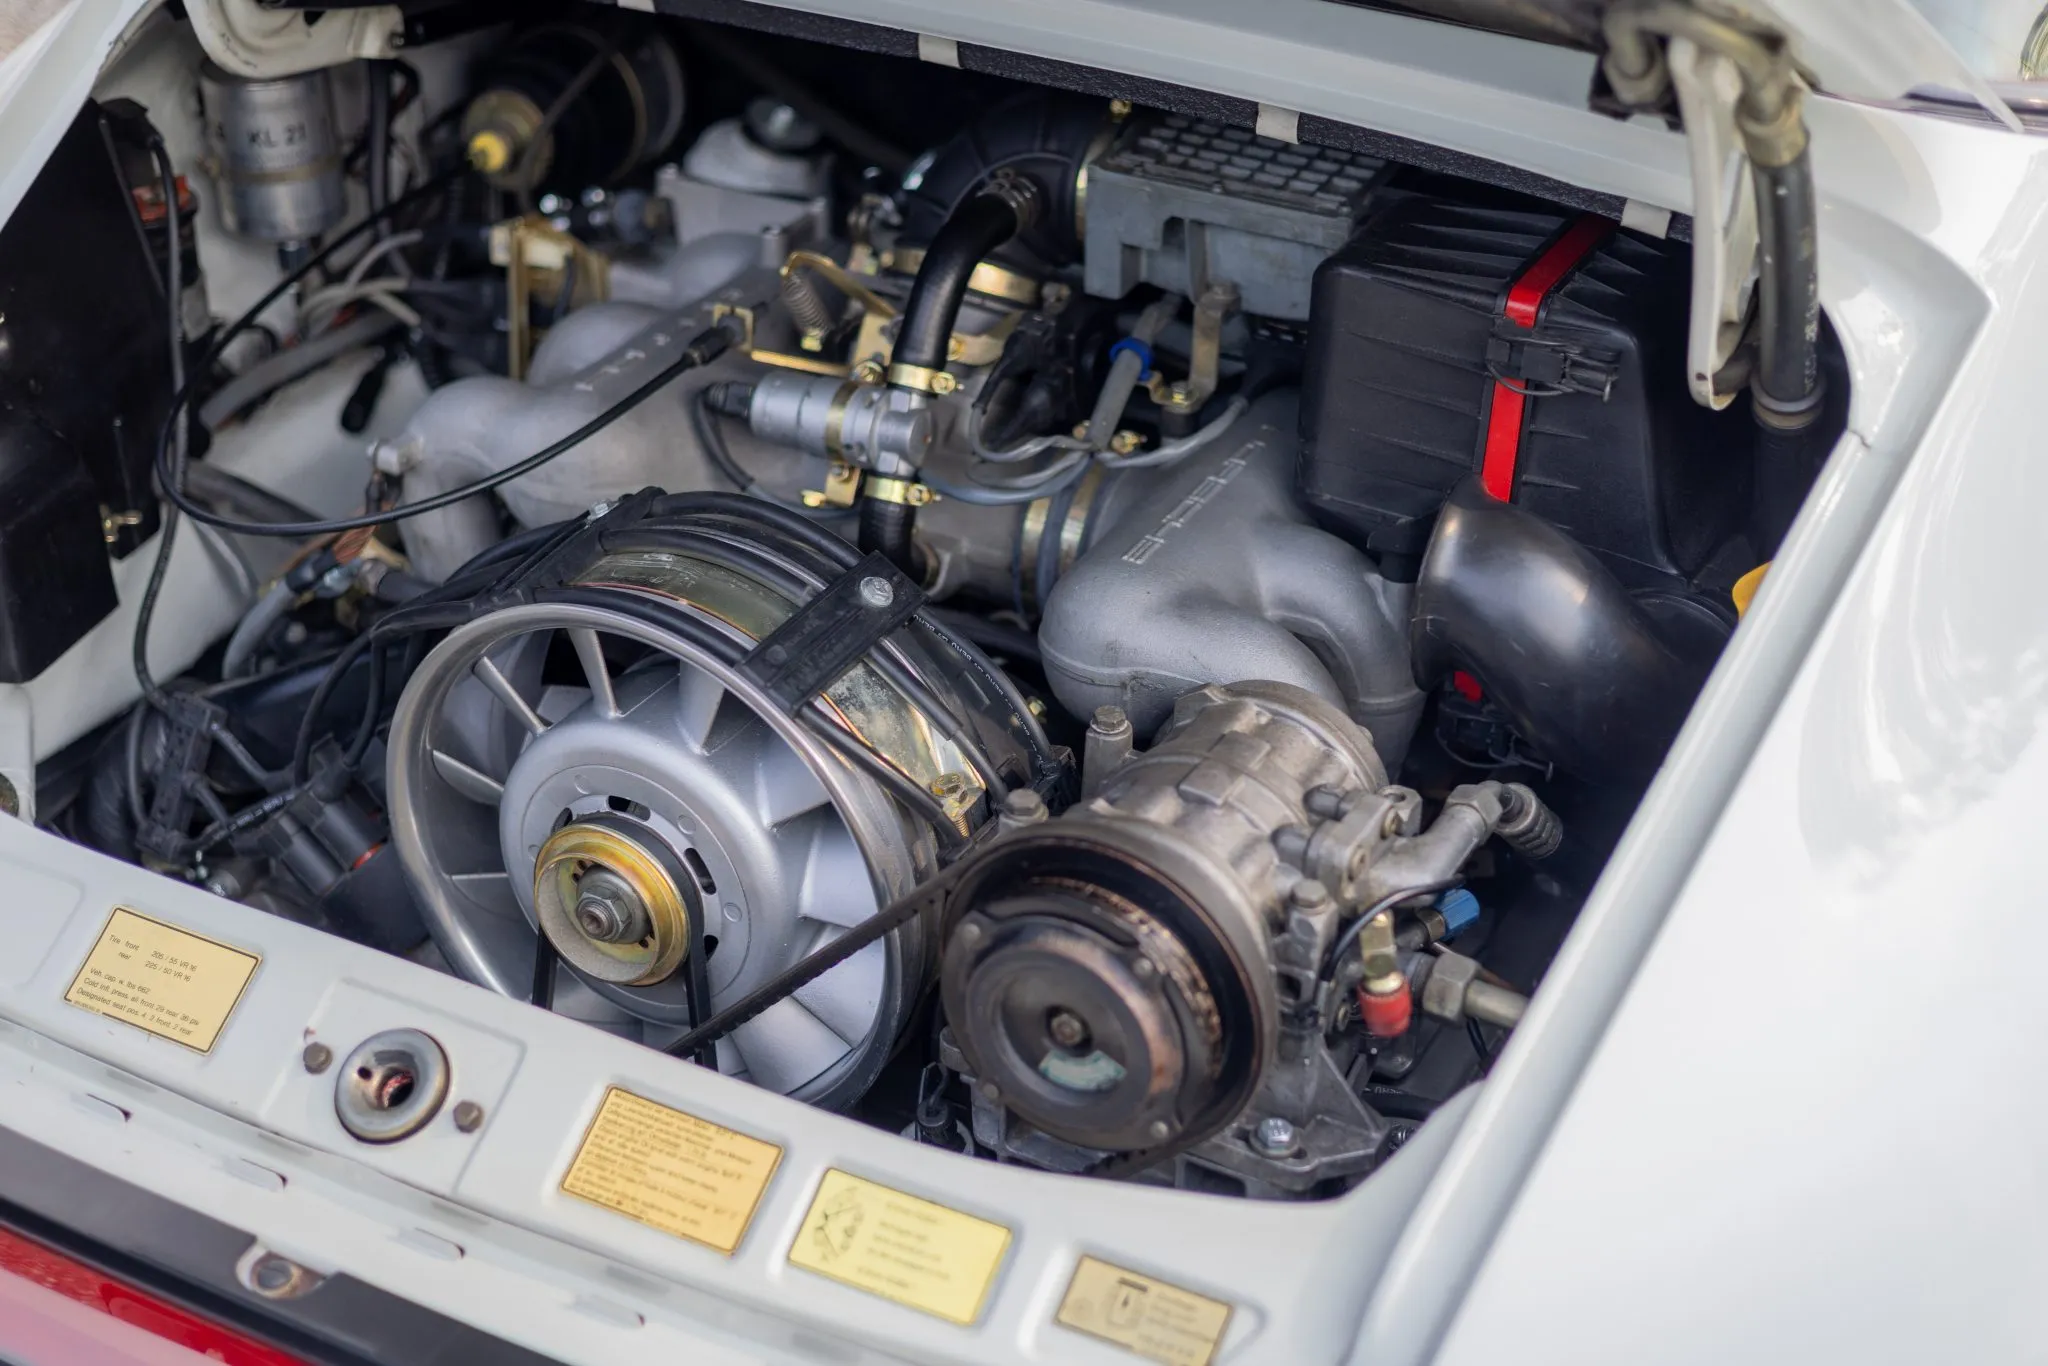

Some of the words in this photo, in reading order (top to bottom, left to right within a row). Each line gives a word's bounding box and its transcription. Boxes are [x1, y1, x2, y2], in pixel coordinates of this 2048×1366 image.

[109, 935, 121, 944] Tire
[125, 941, 140, 950] front
[151, 950, 164, 960] 205
[179, 960, 189, 969] VR
[118, 951, 132, 960] rear
[145, 960, 157, 970] 225
[163, 967, 172, 976] 50
[173, 971, 183, 979] VR
[183, 974, 191, 982] 16
[84, 977, 99, 988] Cold
[76, 986, 112, 1005] Designated
[112, 1001, 127, 1010] seat
[179, 1027, 193, 1035] rear
